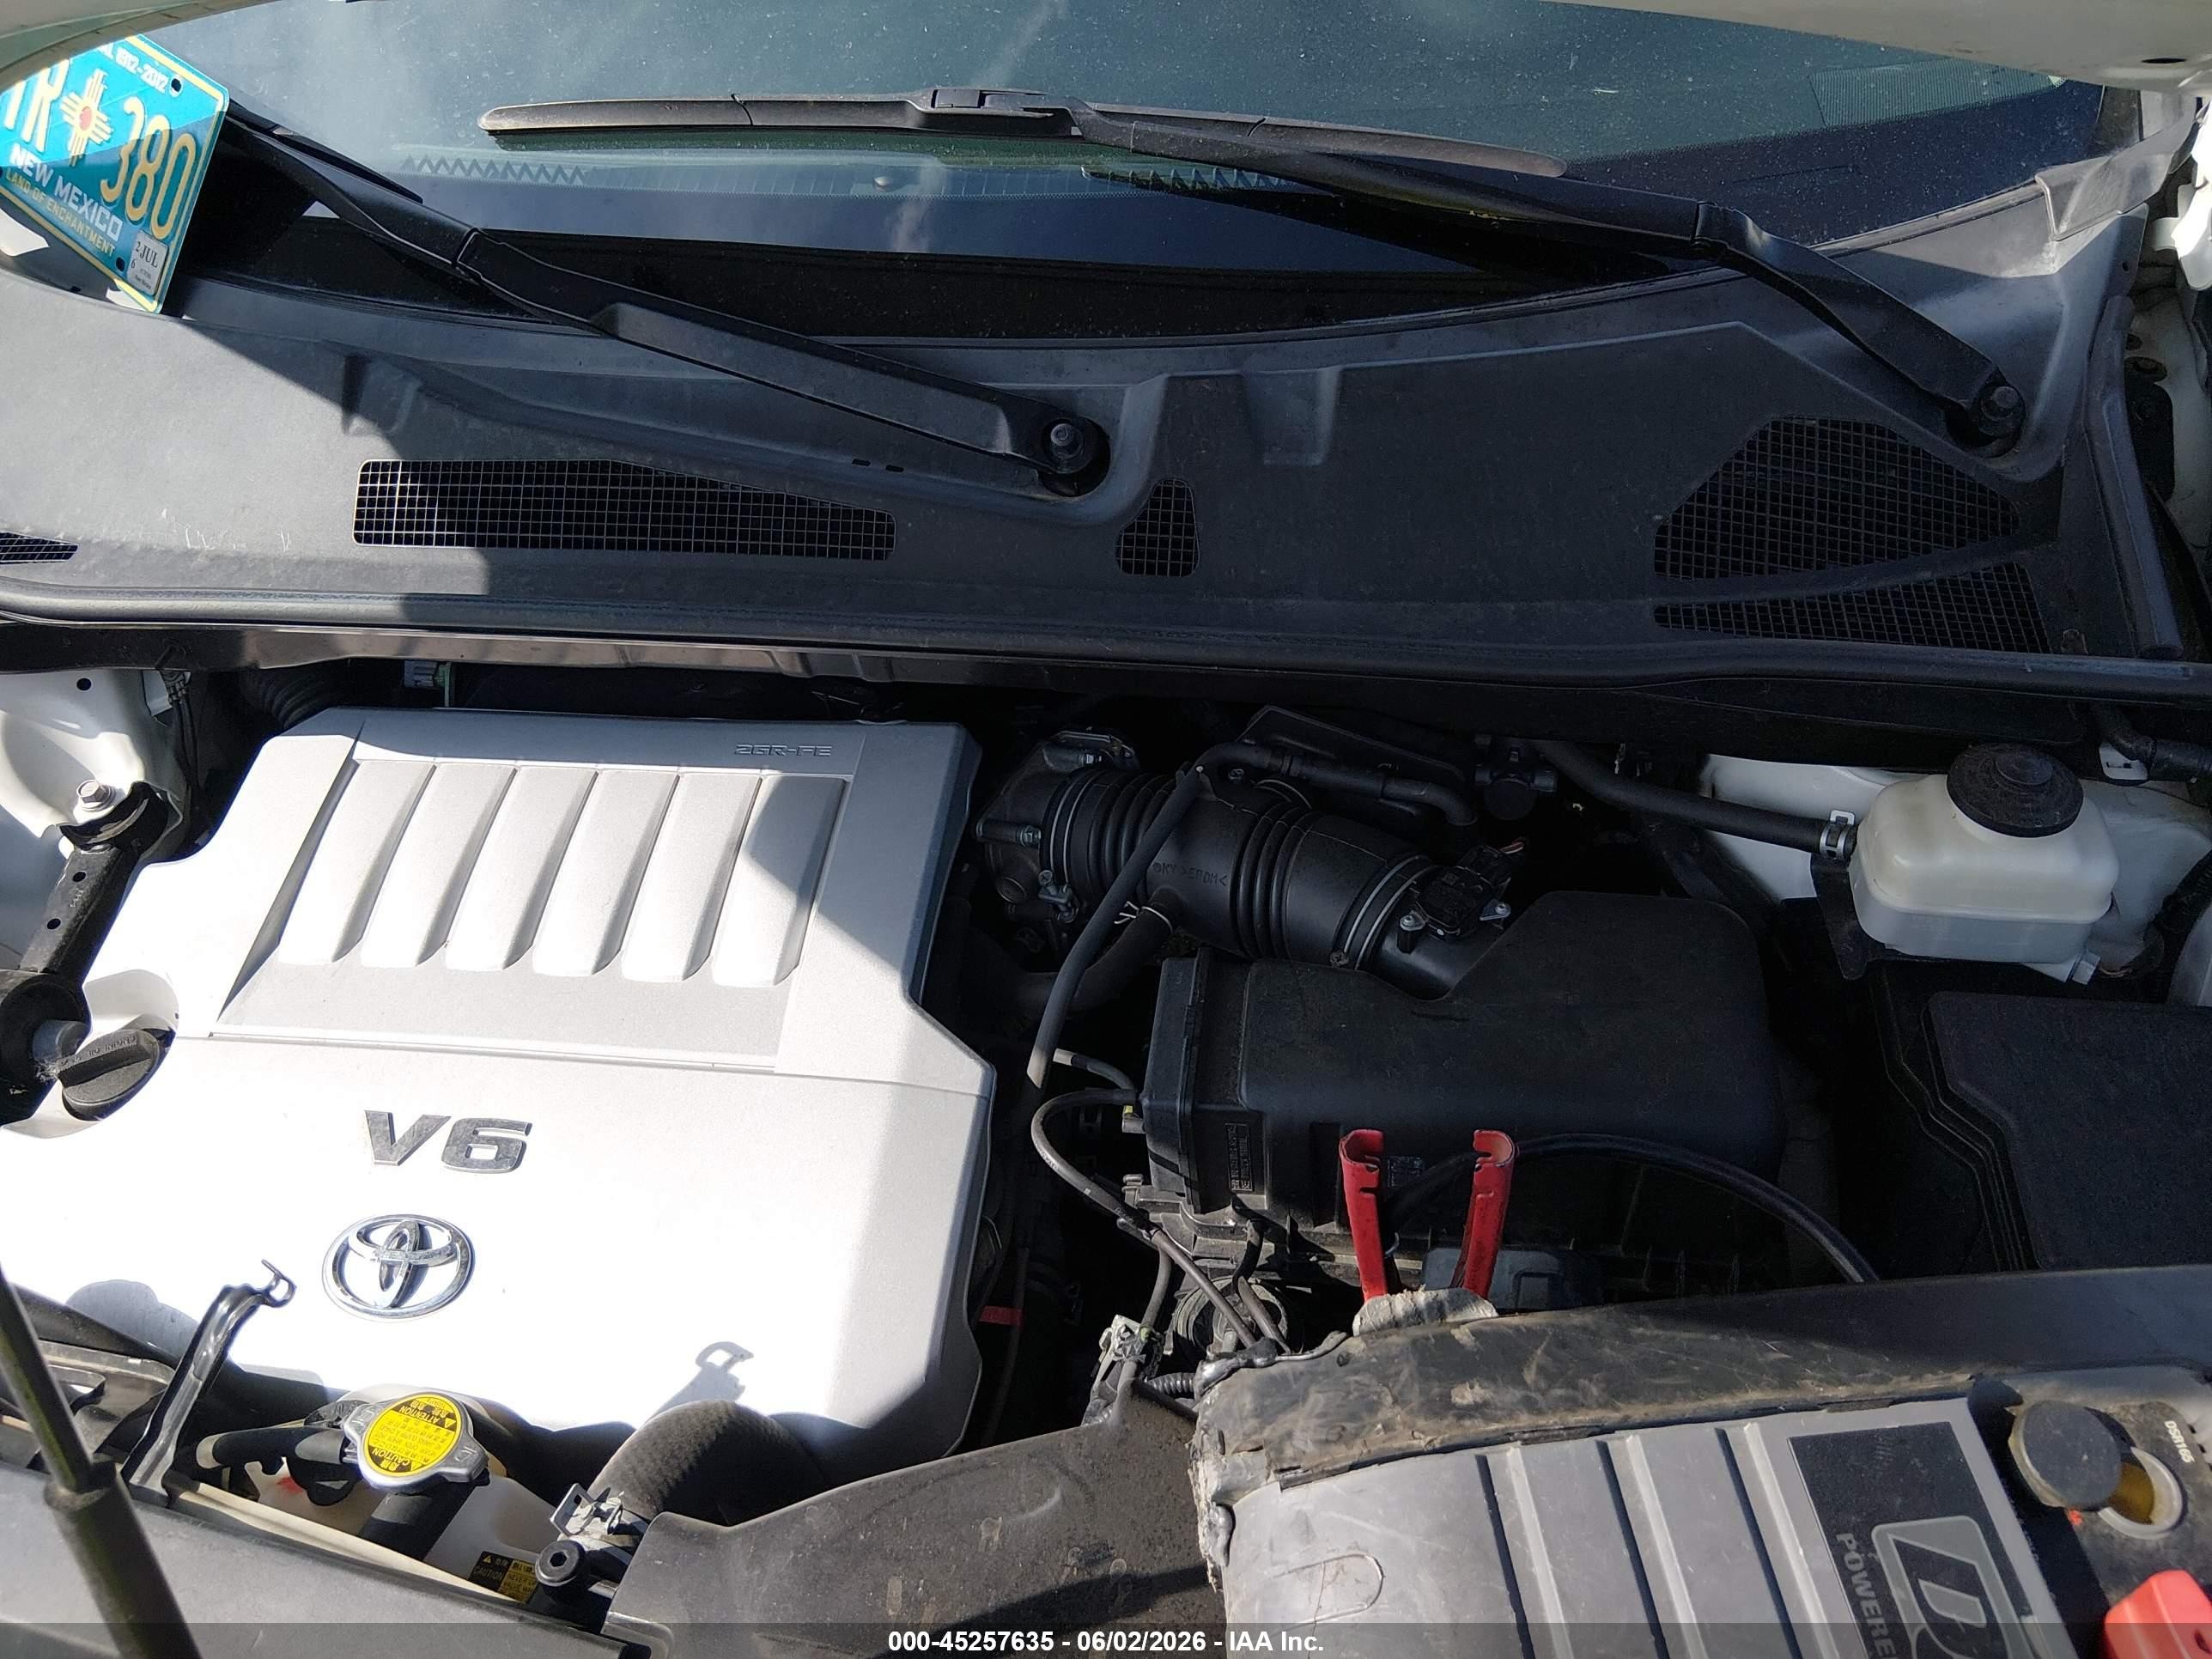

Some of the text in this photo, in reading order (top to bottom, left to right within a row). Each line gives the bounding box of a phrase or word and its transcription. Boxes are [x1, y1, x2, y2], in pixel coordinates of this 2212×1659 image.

[9, 143, 124, 242] NEW MEXICO
[100, 96, 197, 240] 380
[6, 167, 116, 257] LAND OF ENCHANTMENT
[140, 245, 159, 268] JUL
[735, 744, 832, 757] 2GR-FE
[364, 1109, 532, 1174] V6
[398, 1405, 441, 1425] ATTENTION
[2164, 1419, 2196, 1463] DSR165
[371, 1447, 410, 1467] CAUTION
[1836, 1533, 1908, 1659] POWERE
